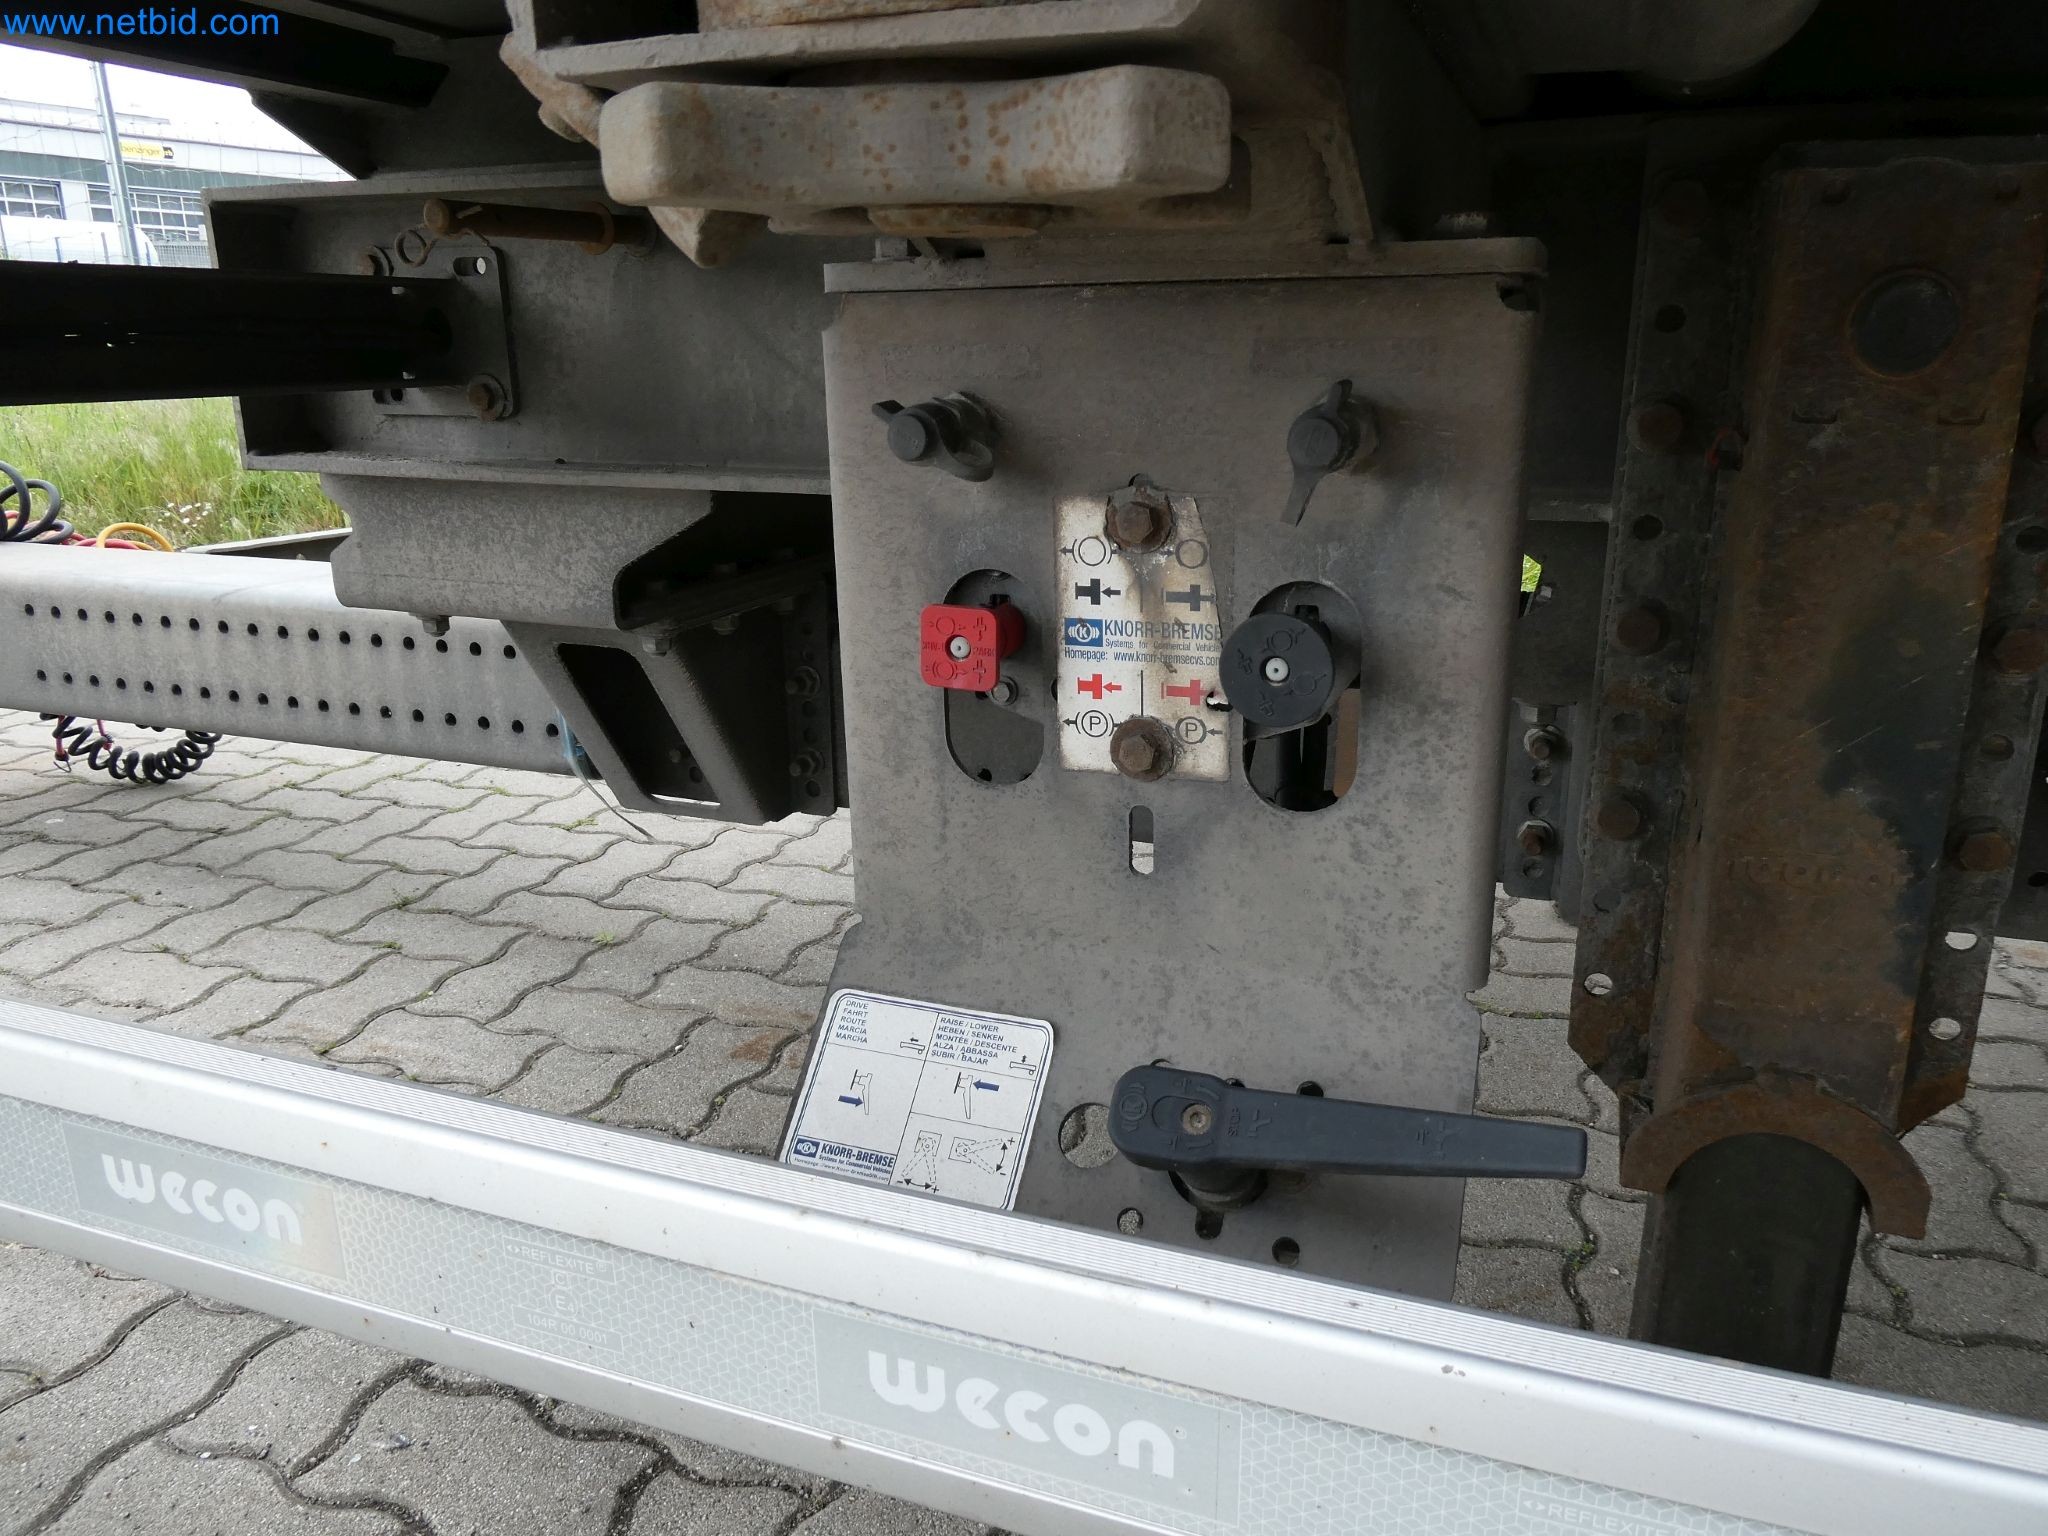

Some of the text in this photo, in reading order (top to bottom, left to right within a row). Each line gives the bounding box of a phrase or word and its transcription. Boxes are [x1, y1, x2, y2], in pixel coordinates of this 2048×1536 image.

[1104, 619, 1221, 641] KNORR-BREMSE
[1105, 638, 1220, 652] Systems for Commercial Vehicle
[1064, 646, 1108, 662] Homepage:
[1089, 715, 1101, 731] P
[1184, 722, 1198, 738] P
[843, 1007, 868, 1018] FAHRT
[845, 1000, 869, 1010] DRIVE
[840, 1015, 866, 1026] ROUTE
[940, 1017, 964, 1026] RAISE
[969, 1022, 999, 1033] LOWER
[837, 1024, 867, 1034] MARCIA
[937, 1025, 965, 1035] HEBEN
[971, 1030, 1004, 1042] SENKEN
[835, 1032, 868, 1043] MARCHA
[933, 1041, 954, 1051] ALZA
[960, 1046, 998, 1058] ABBASSA
[974, 1039, 1018, 1053] DESCENTE
[931, 1049, 955, 1060] SUBIR
[961, 1054, 989, 1065] BAJAR
[820, 1142, 895, 1168] KNORR-BREMSE
[818, 1154, 838, 1164] Systems
[845, 1159, 872, 1171] Commercial
[872, 1165, 891, 1175] Vehicles
[102, 1153, 302, 1245] wecon
[527, 1312, 607, 1345] 104R 00 0001
[868, 1349, 1175, 1480] wecon
[1547, 1503, 1670, 1536] REFLEXITE
